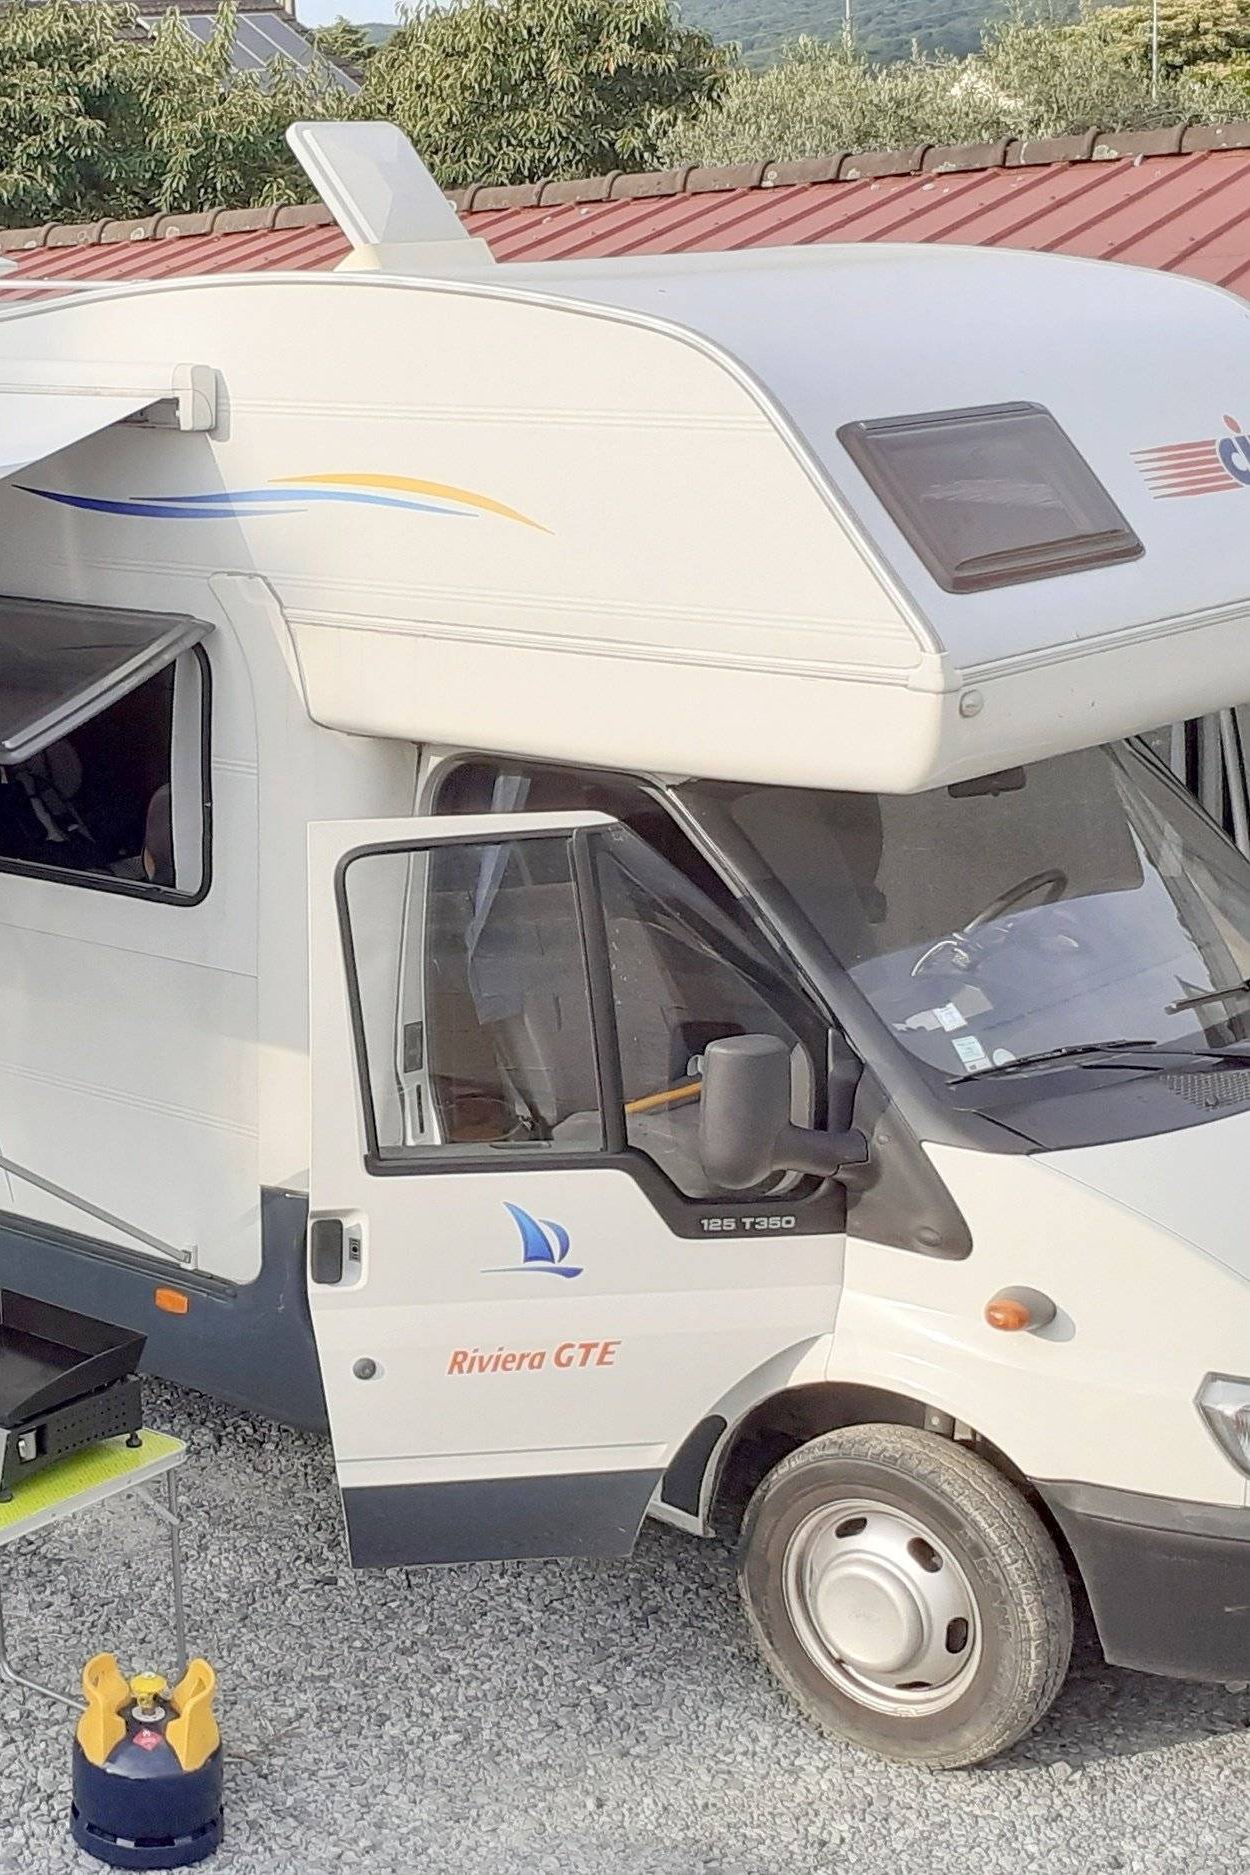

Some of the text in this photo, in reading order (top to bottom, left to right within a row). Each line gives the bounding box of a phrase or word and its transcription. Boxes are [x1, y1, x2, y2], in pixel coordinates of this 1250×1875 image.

[701, 1216, 796, 1231] 125 T350
[448, 1340, 622, 1375] Riviera GTE
